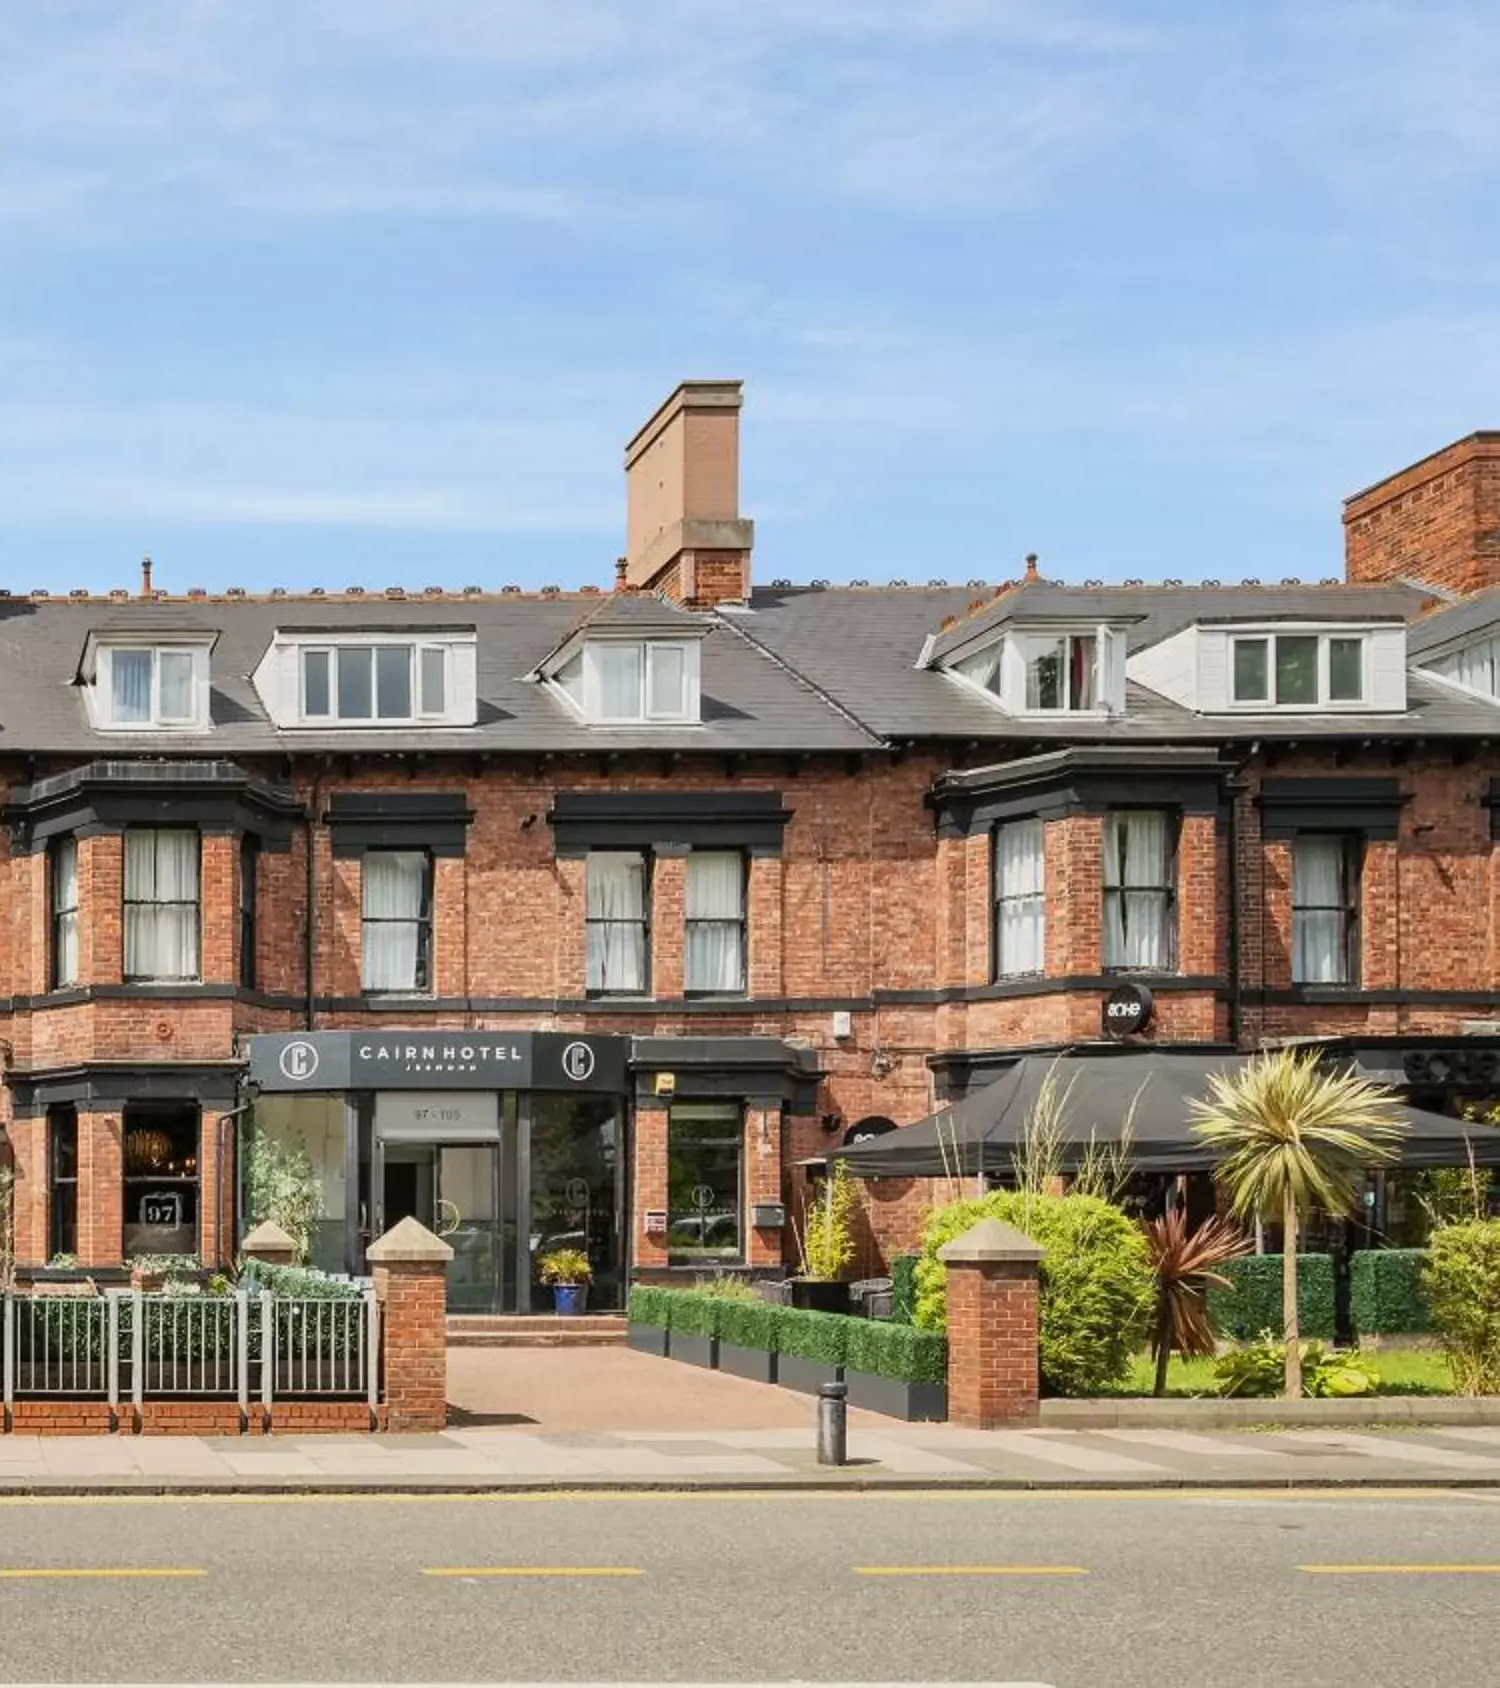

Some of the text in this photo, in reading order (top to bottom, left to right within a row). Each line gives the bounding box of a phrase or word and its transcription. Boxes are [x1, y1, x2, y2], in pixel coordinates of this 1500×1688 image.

[360, 1045, 522, 1060] CAIRN HOTEL
[147, 1206, 173, 1221] 97
